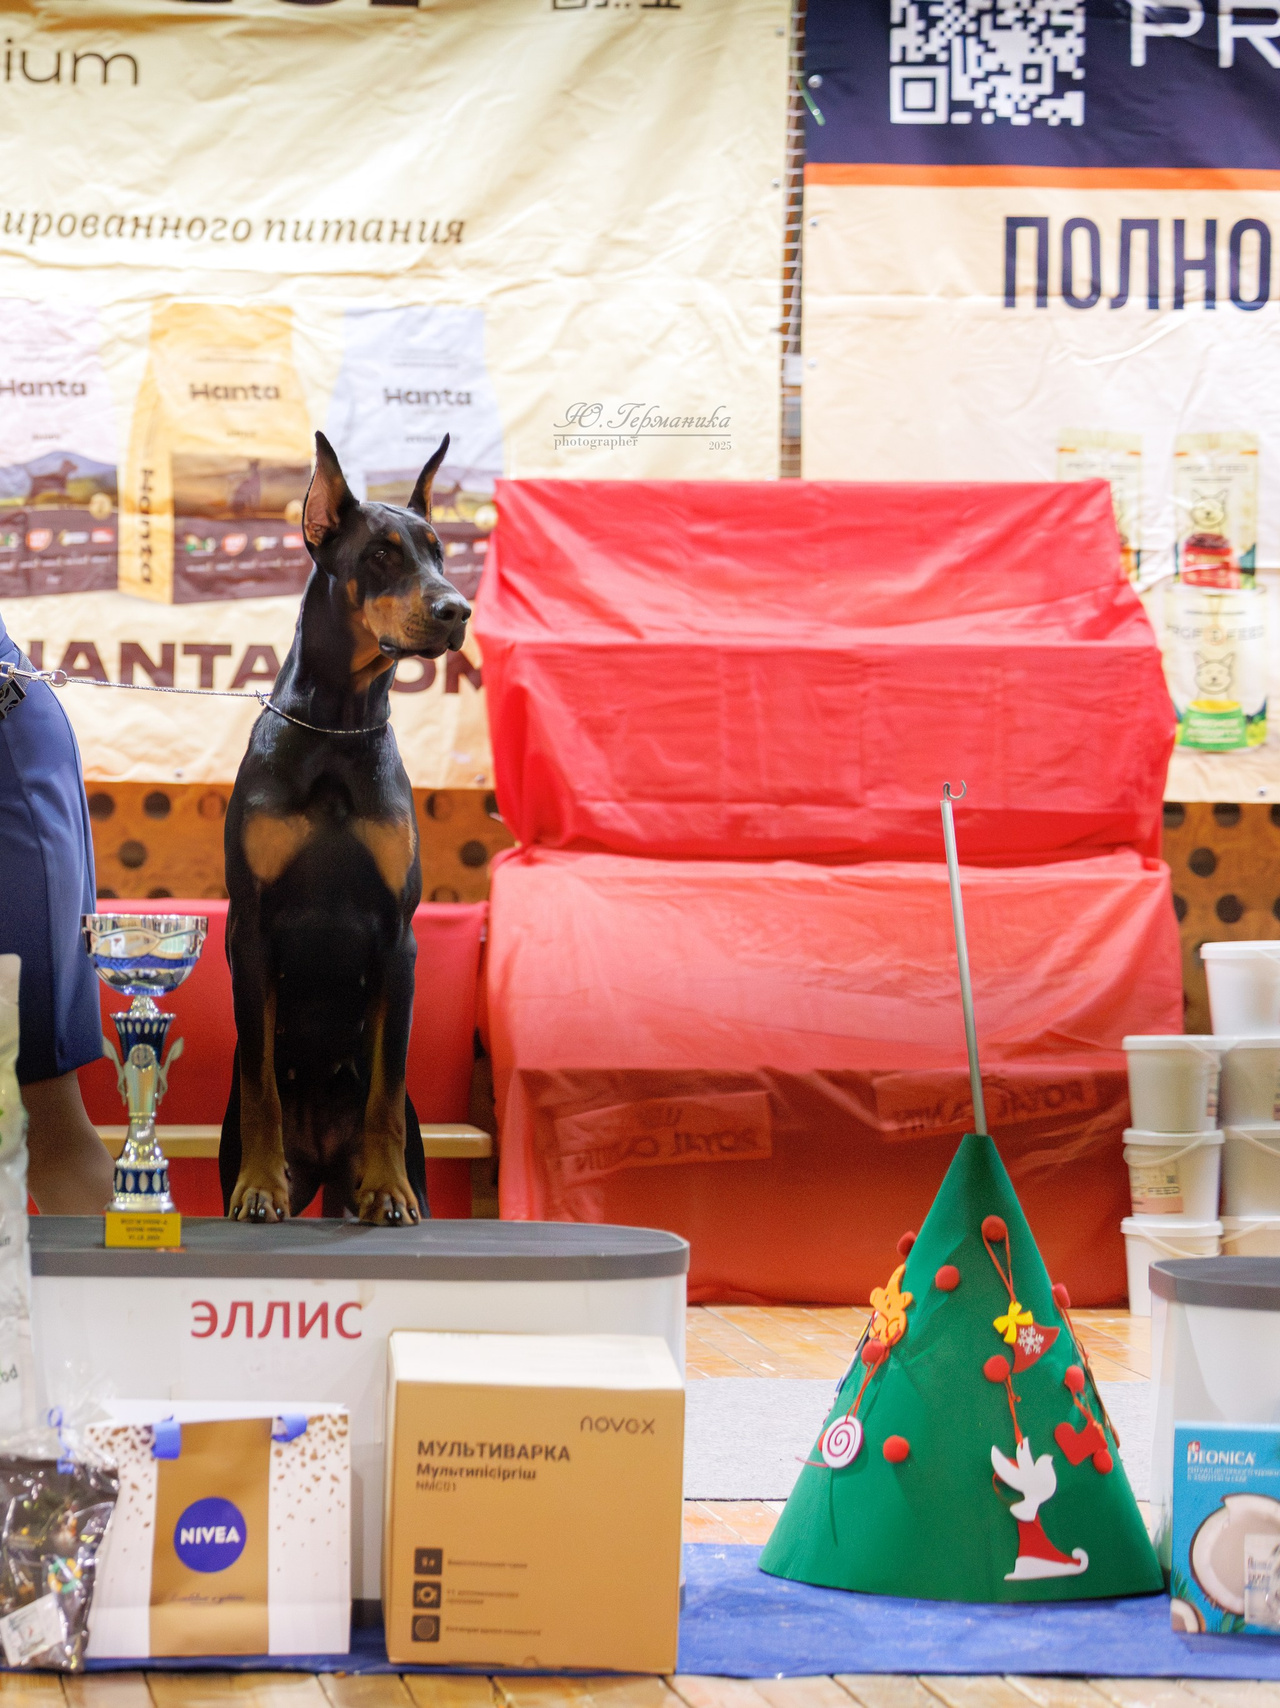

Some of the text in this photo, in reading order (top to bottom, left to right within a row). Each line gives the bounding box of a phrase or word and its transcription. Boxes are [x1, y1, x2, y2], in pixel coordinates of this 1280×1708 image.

[262, 215, 467, 246] питания
[188, 382, 282, 402] Hanta
[382, 386, 473, 407] Hanta
[189, 1300, 363, 1340] ЭЛЛИС
[579, 1415, 656, 1435] novox
[416, 1440, 572, 1462] МУЛЬТИВАРКА
[179, 1525, 241, 1546] NIVEA
